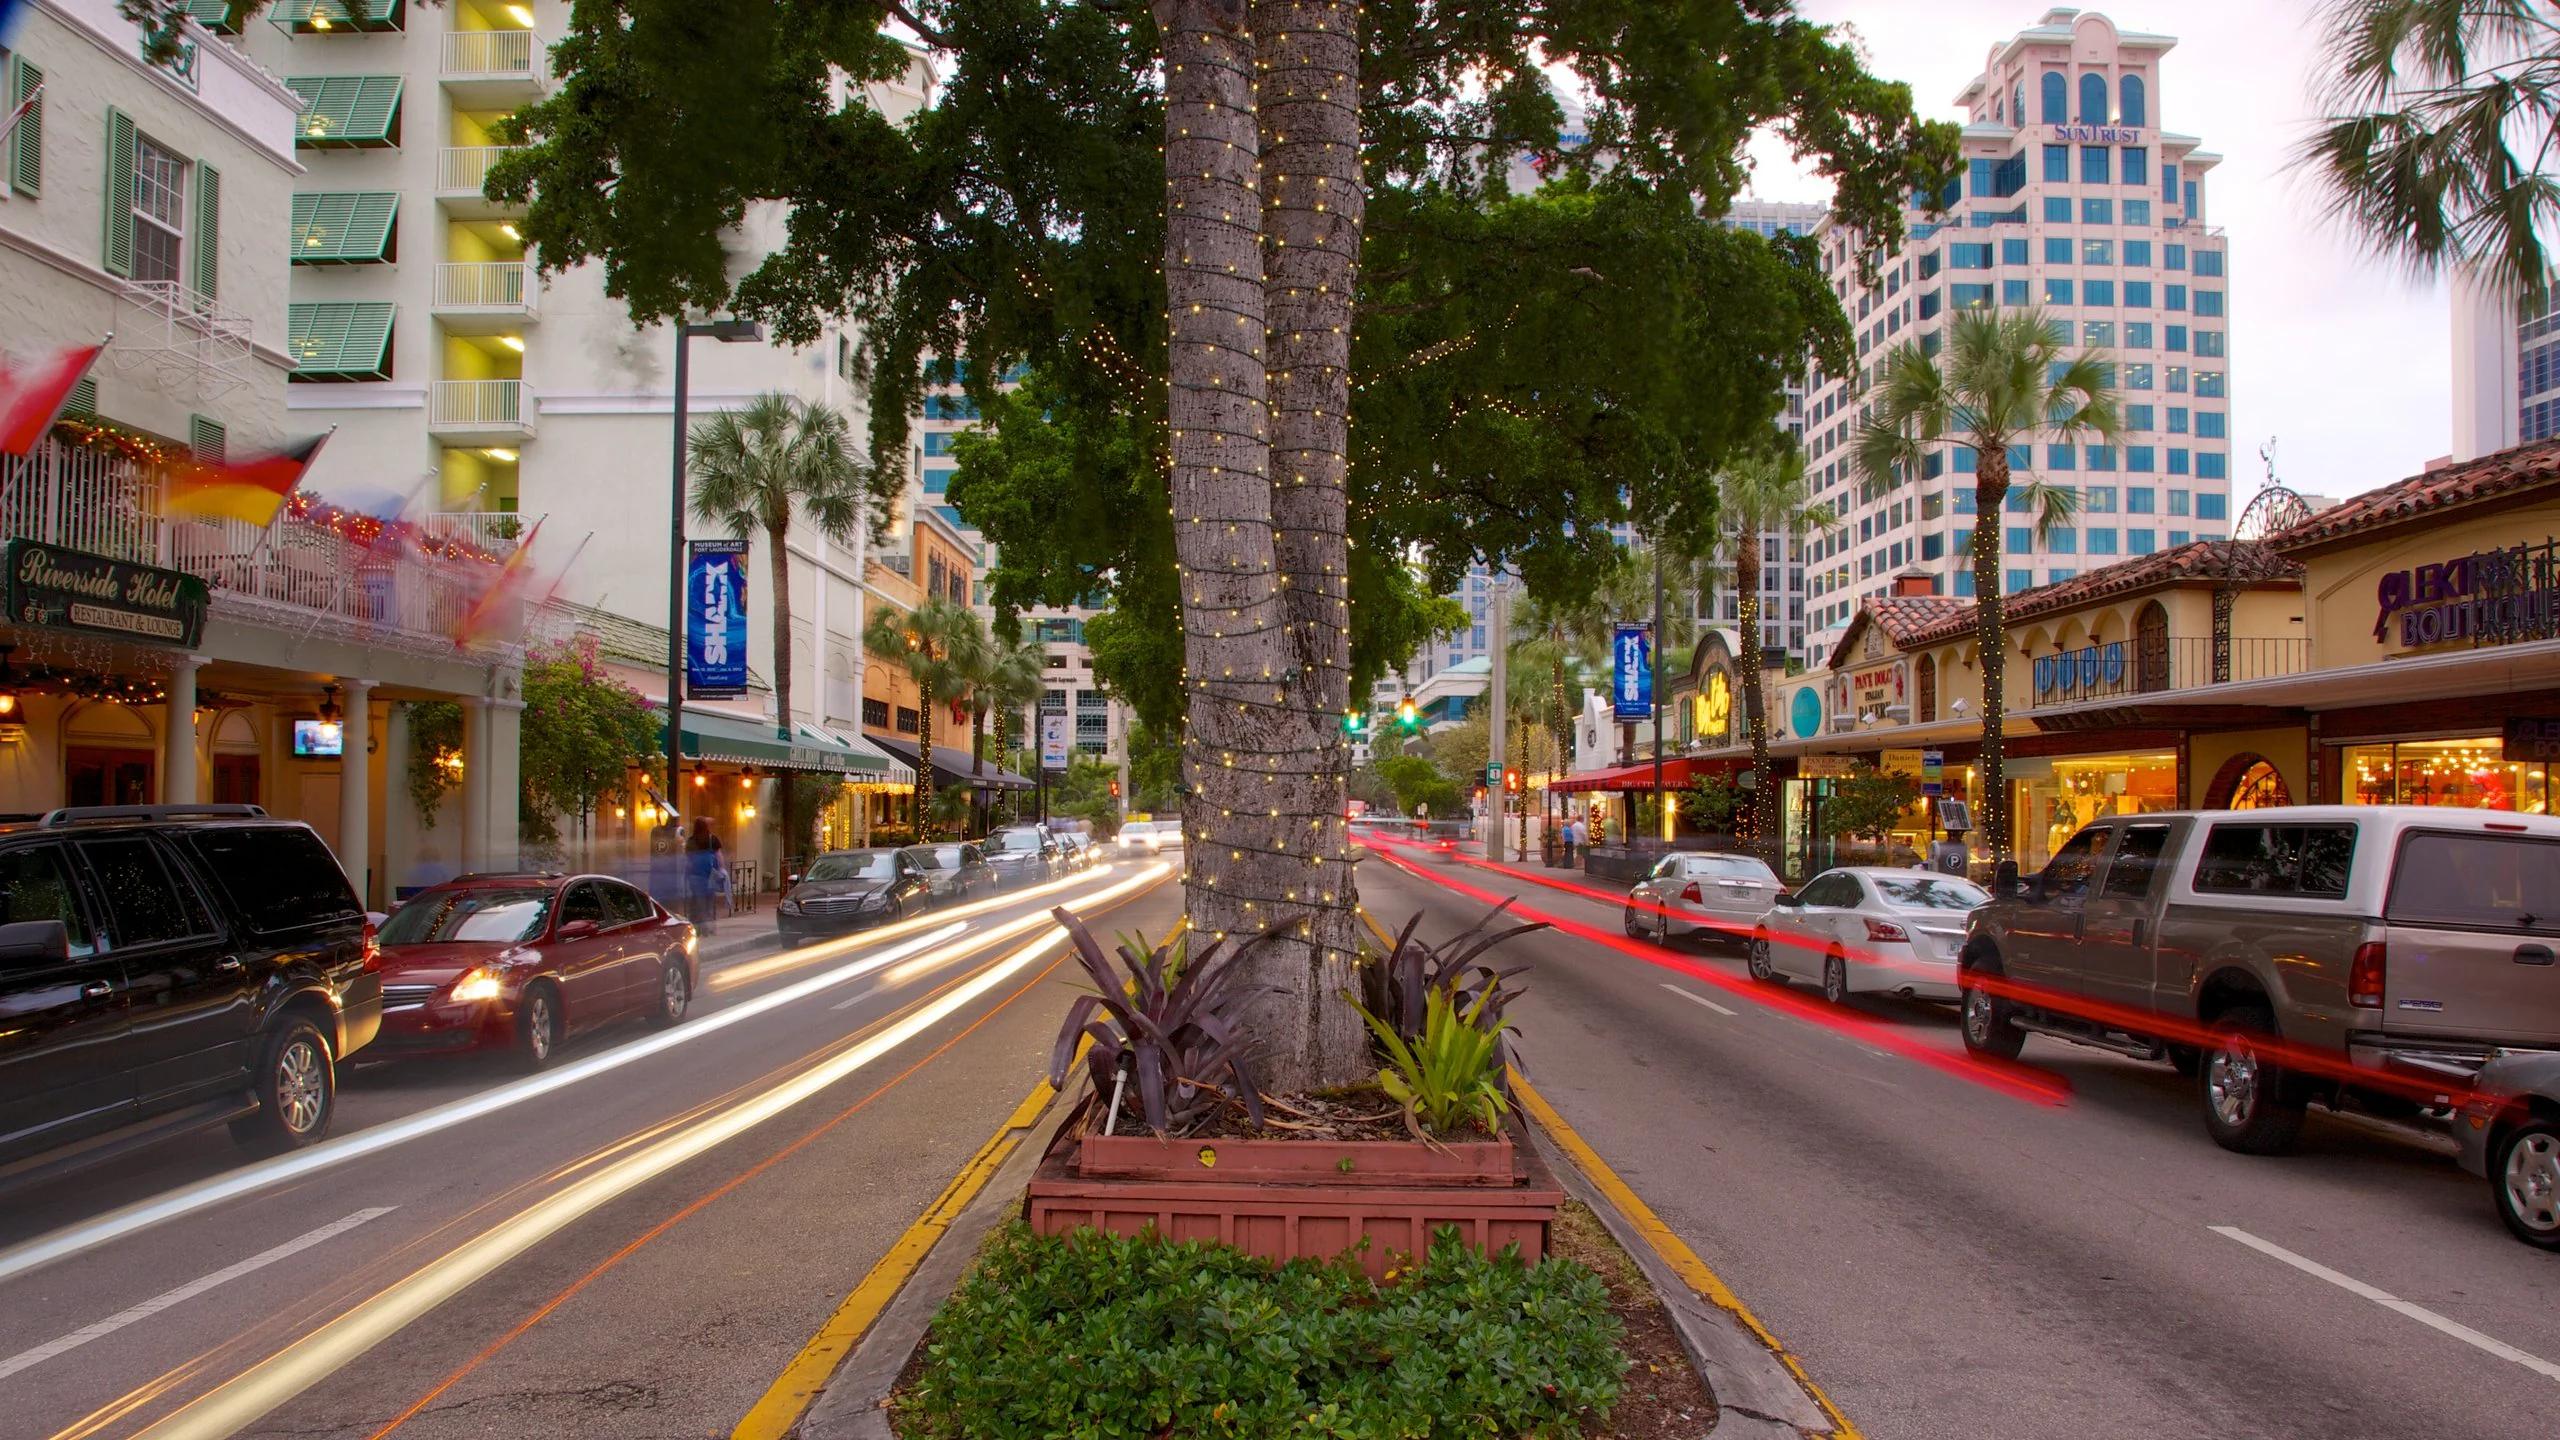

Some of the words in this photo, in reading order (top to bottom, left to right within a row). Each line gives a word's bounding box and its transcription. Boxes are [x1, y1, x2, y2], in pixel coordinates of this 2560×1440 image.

[19, 548, 119, 598] Riverside
[126, 572, 182, 609] Hotel
[73, 605, 134, 630] RESTAURANT
[136, 615, 144, 631] &
[147, 618, 182, 637] LOUNGE
[704, 560, 729, 666] SHARK
[1951, 856, 1959, 866] P
